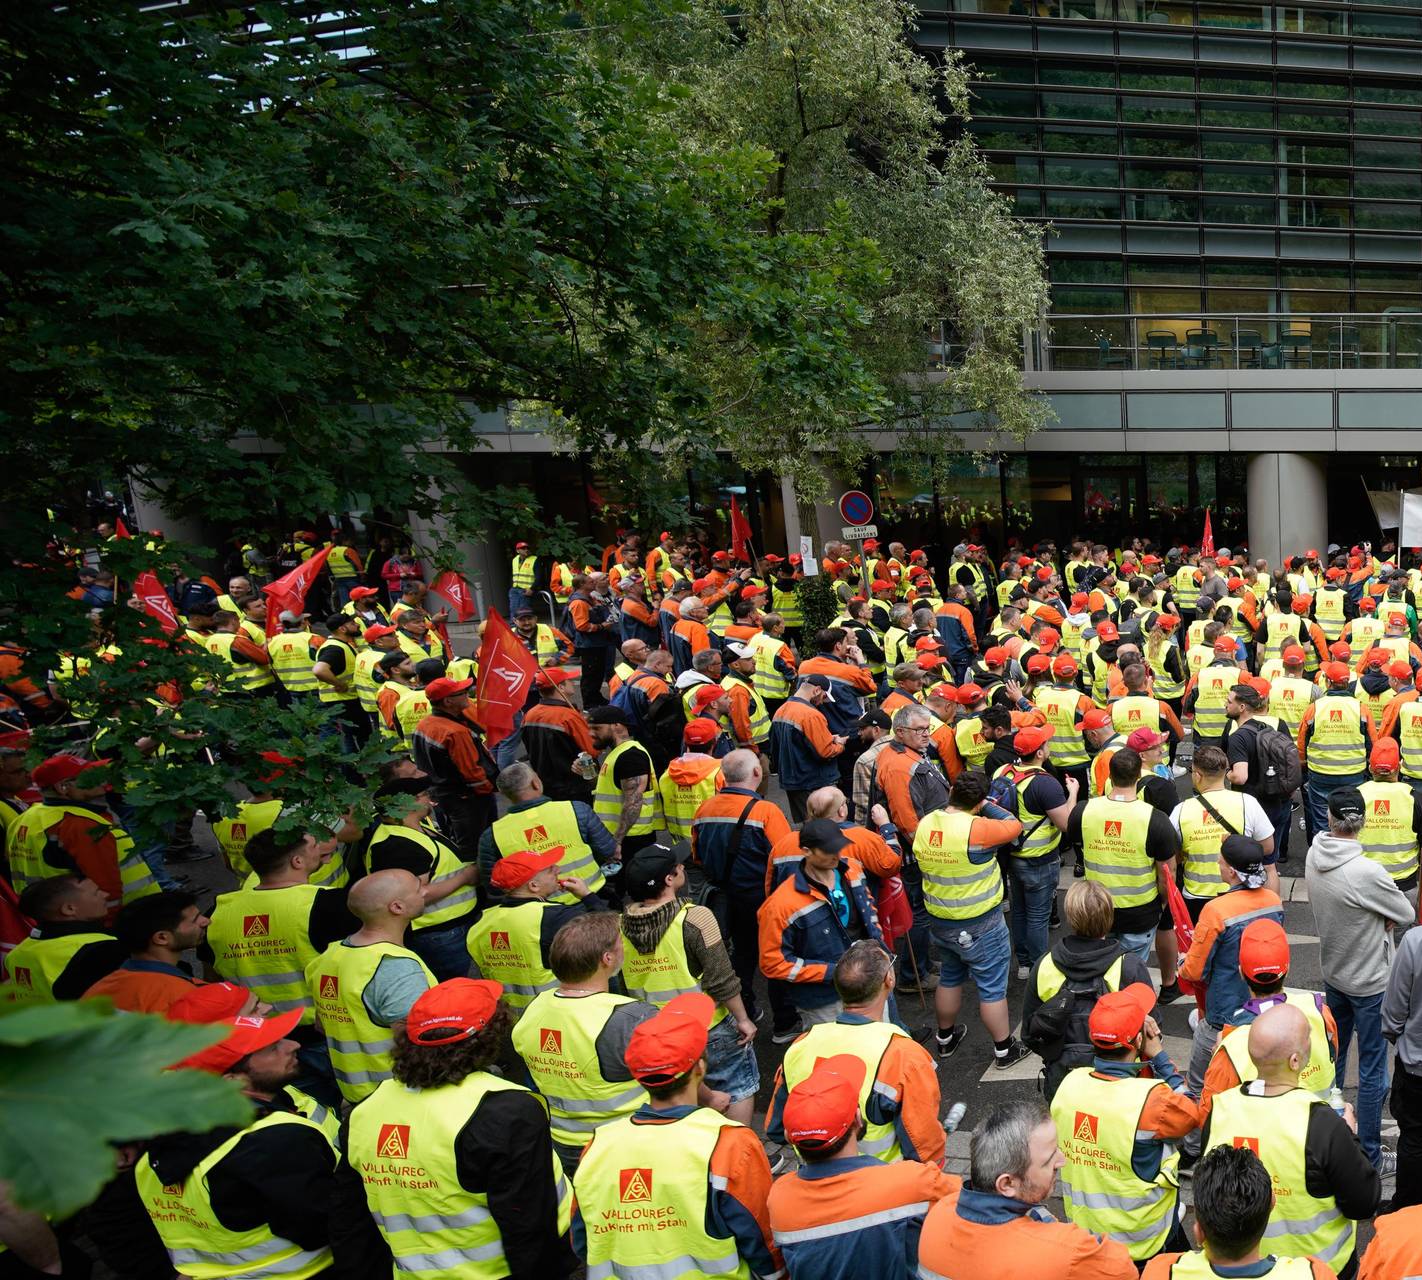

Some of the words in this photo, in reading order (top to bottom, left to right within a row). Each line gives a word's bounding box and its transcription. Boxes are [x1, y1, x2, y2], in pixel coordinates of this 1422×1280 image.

[1094, 839, 1131, 847] VALLOUREC
[228, 939, 285, 950] VALLOUREC
[273, 946, 297, 955] Stahl
[528, 1055, 577, 1069] VALLOUREC
[1098, 1161, 1121, 1173] Stahl
[410, 1179, 438, 1189] Stahl
[1272, 1187, 1292, 1196] tahl
[601, 1206, 676, 1220] VALLOUREC
[656, 1218, 688, 1231] Stahl
